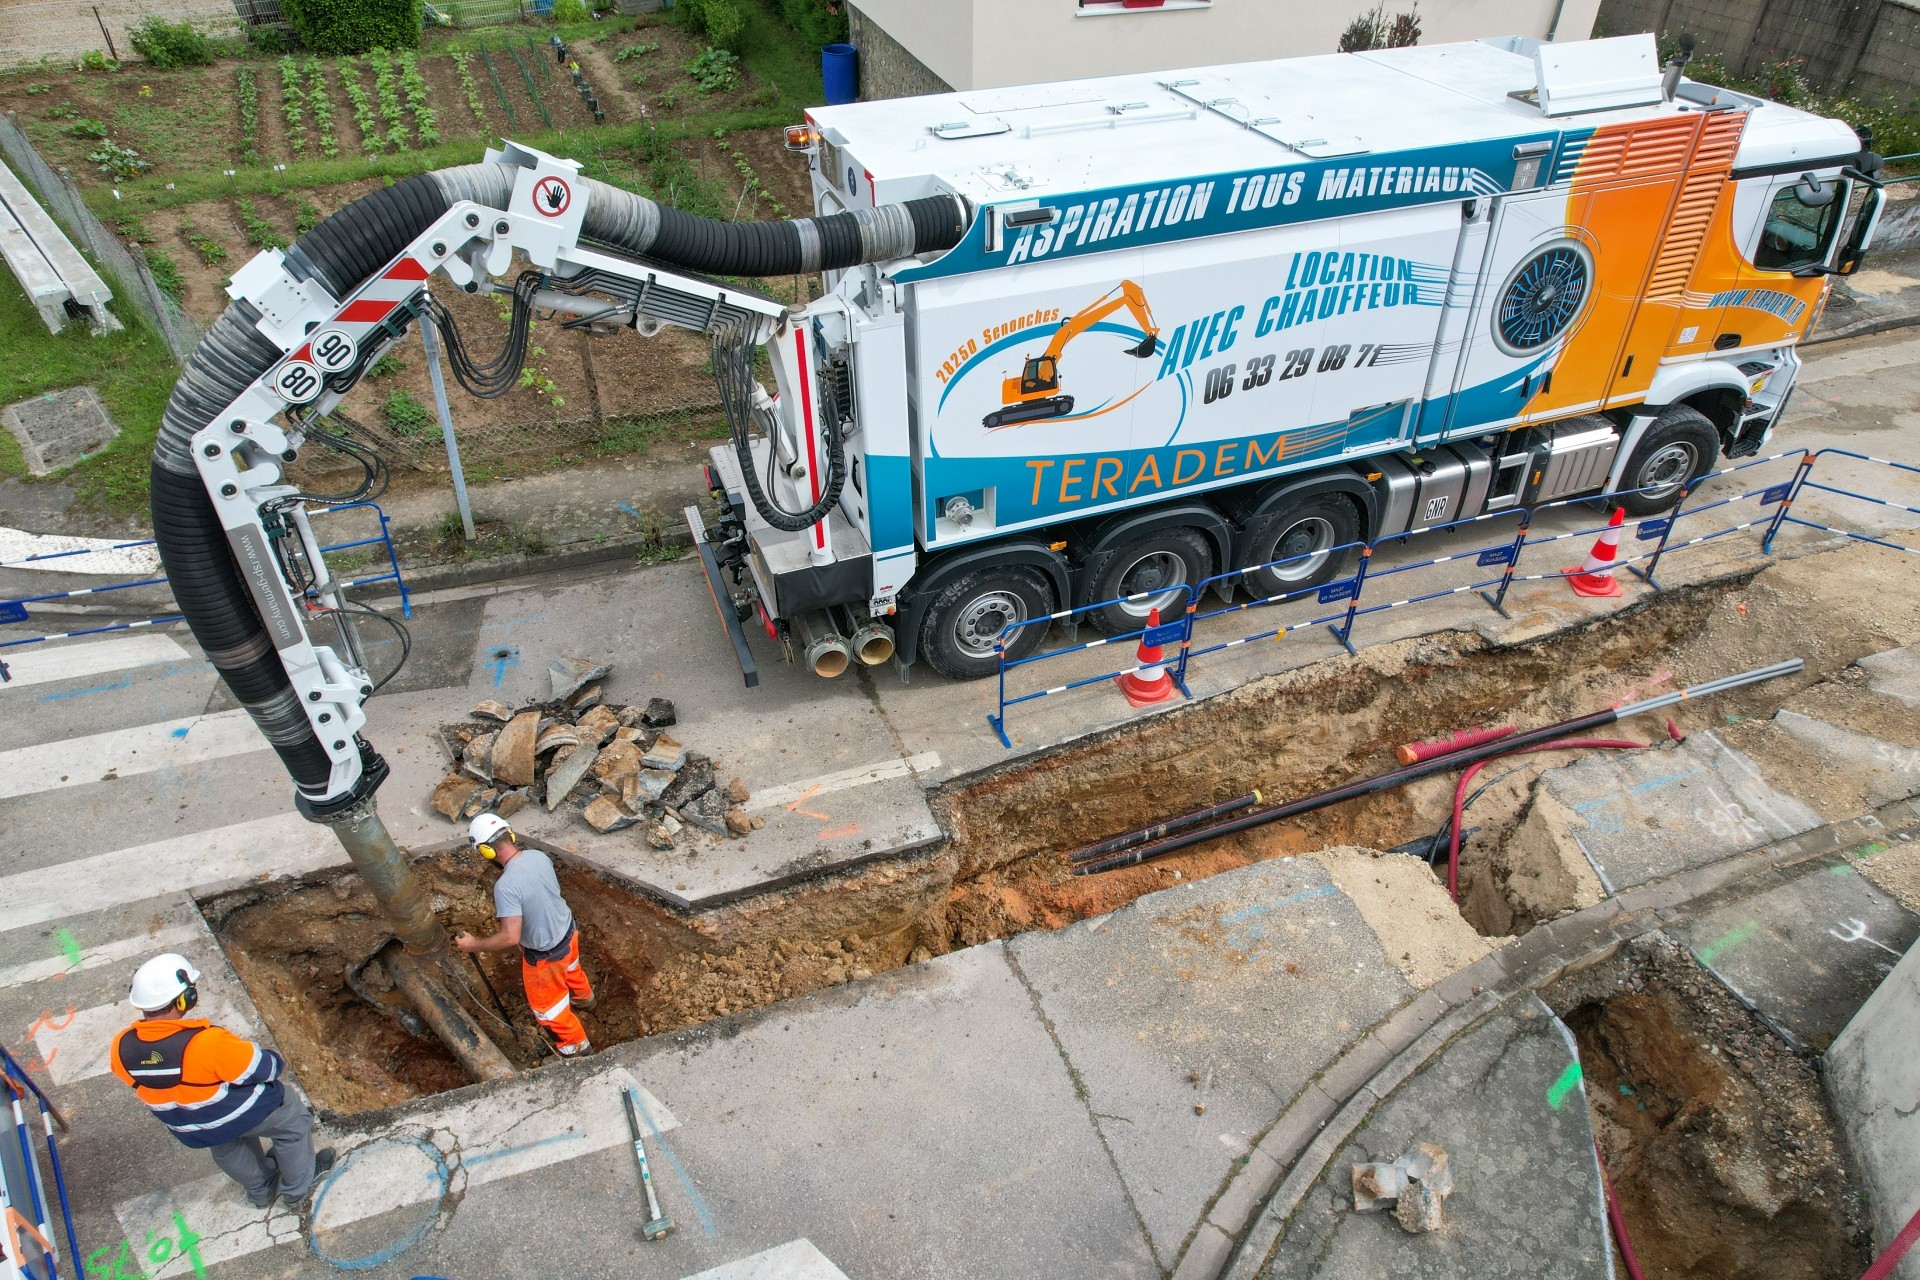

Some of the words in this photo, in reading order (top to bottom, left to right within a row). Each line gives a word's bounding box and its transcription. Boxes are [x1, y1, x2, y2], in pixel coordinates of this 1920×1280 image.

[1006, 181, 1216, 265] ASPIRATION
[1226, 172, 1305, 214] TOUS
[1317, 167, 1475, 201] MATERIAUX
[1285, 251, 1411, 290] LOCATION
[317, 335, 351, 366] 90
[936, 338, 978, 384] 28250
[982, 308, 1060, 345] Senonches
[1157, 305, 1245, 381] AVEC
[1254, 283, 1417, 338] CHAUFFEUR
[281, 367, 317, 397] 80
[1204, 364, 1237, 404] 06
[1242, 354, 1275, 391] 33
[1279, 347, 1315, 381] 29
[1317, 344, 1351, 373] 08
[1353, 344, 1385, 368] 71
[1026, 435, 1287, 505] TERADEM
[1425, 497, 1446, 520] GNR
[241, 534, 292, 640] www.rsp-germany.com
